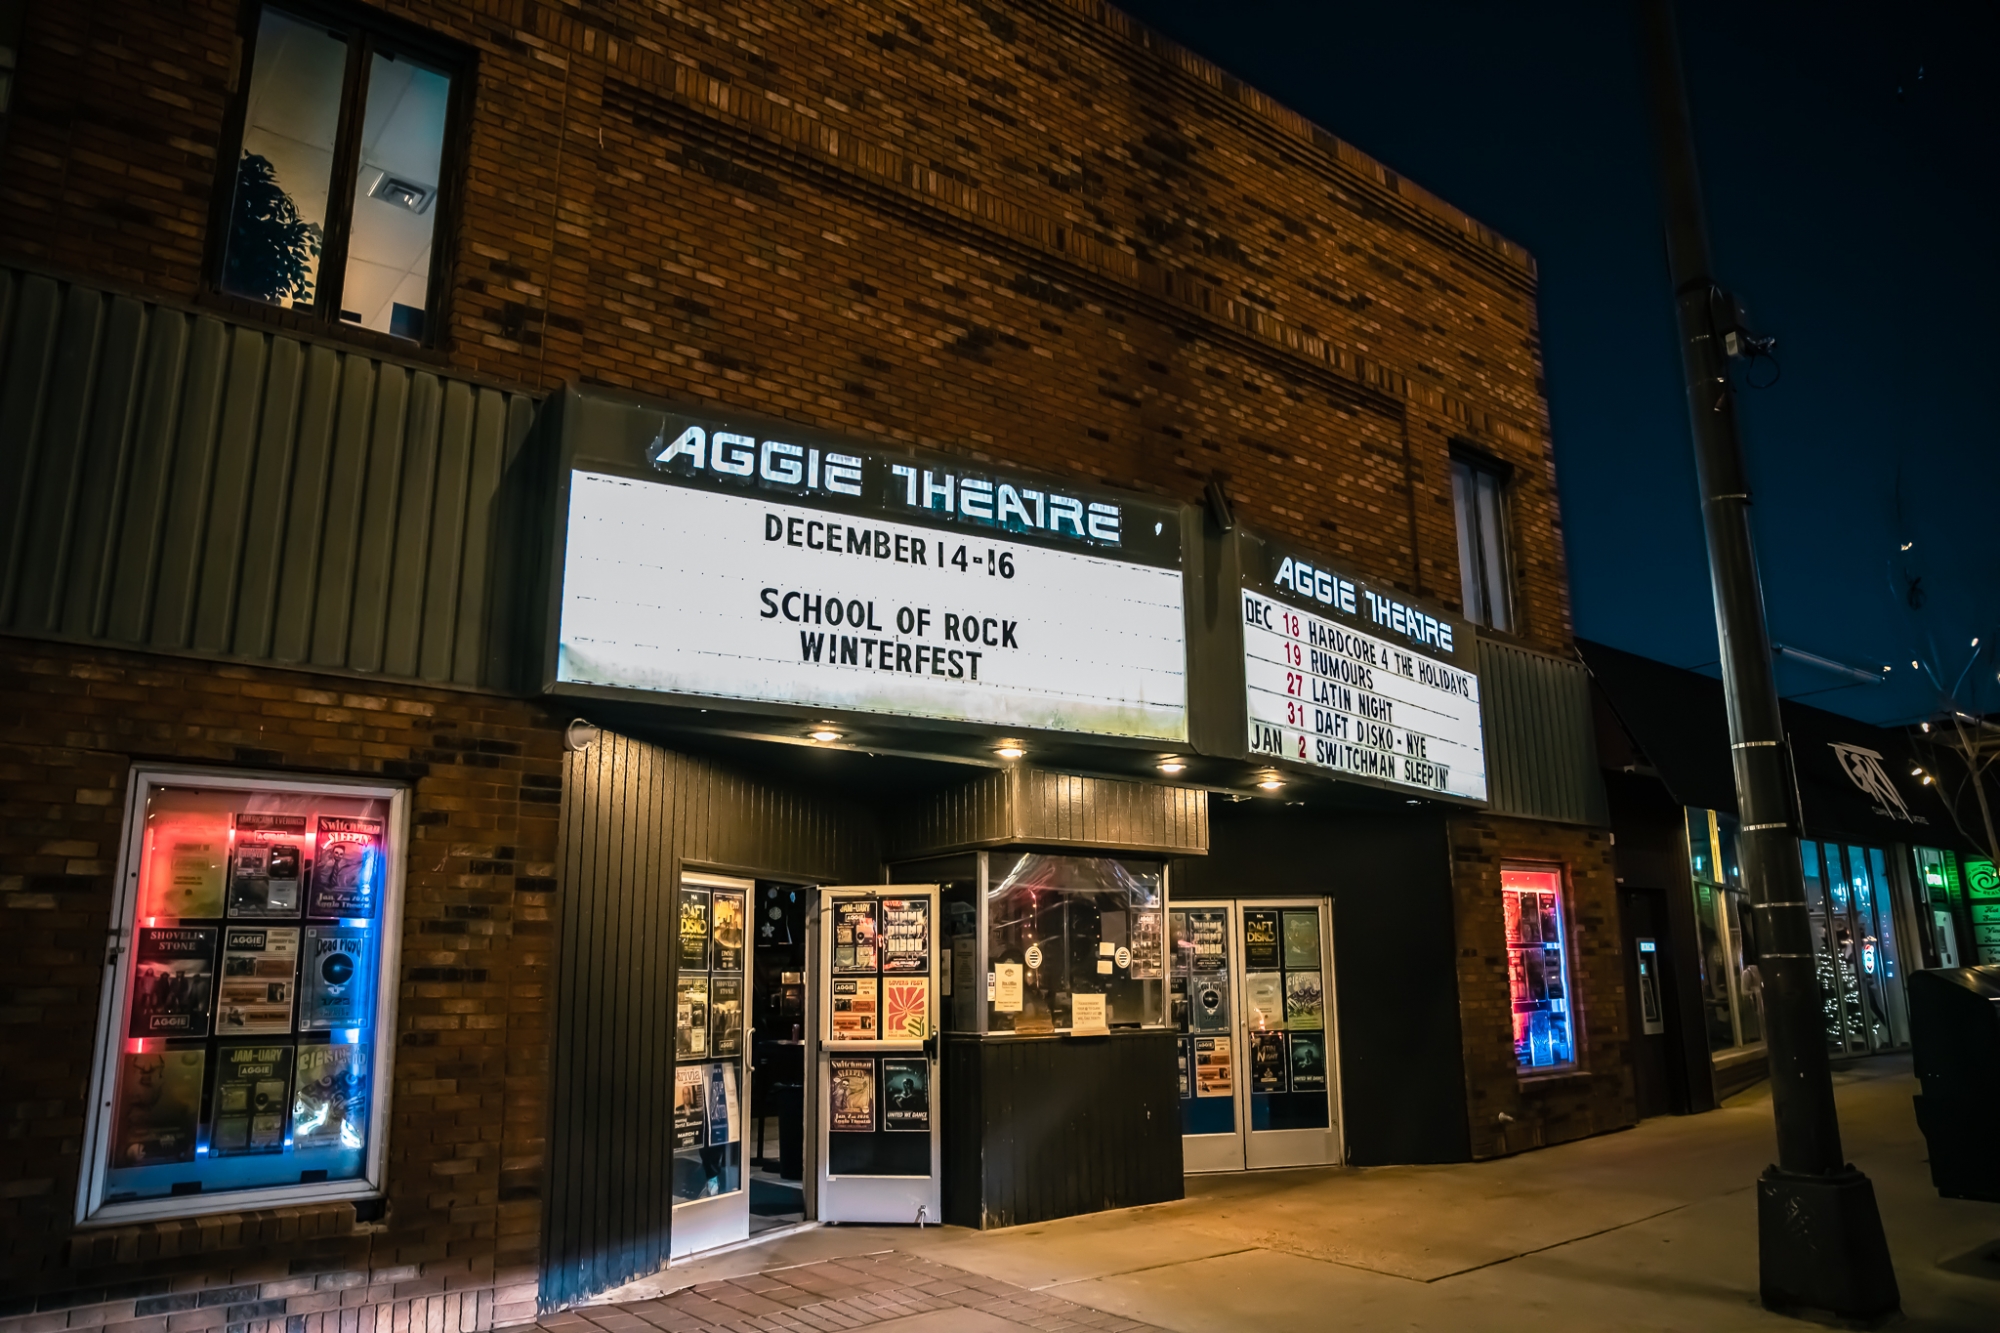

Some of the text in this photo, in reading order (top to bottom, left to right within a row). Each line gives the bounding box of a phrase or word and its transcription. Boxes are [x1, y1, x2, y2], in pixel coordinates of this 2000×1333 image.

[655, 426, 1120, 542] AGGIE THEATRE
[765, 513, 1015, 580] DECEMBER 14-16
[760, 587, 1019, 650] SCHOOL OF ROCK
[1274, 556, 1453, 653] AGGIE THEATRE
[800, 630, 982, 681] WINTERFEST
[1245, 597, 1469, 698] DEC 18 HARDCORE 4 THE HOLIDAYS
[1284, 641, 1374, 690] 19 RUMOURS
[1286, 672, 1393, 723] 27 LATIN NIGHT
[1287, 701, 1304, 727] 31
[1315, 709, 1348, 739] DAFT
[1250, 724, 1449, 790] JAN 2 SWITCHMAN SLEEPIN'
[682, 903, 706, 919] DAFT
[232, 936, 263, 945] AGGIE
[680, 919, 707, 935] DISKO
[1247, 932, 1275, 942] DISKO
[1248, 921, 1273, 932] DAFT
[159, 942, 196, 951] STONE
[316, 938, 338, 957] Dead
[153, 1017, 187, 1026] AGGIE
[231, 1048, 283, 1063] JAM-UARY
[241, 1066, 270, 1075] AGGIE
